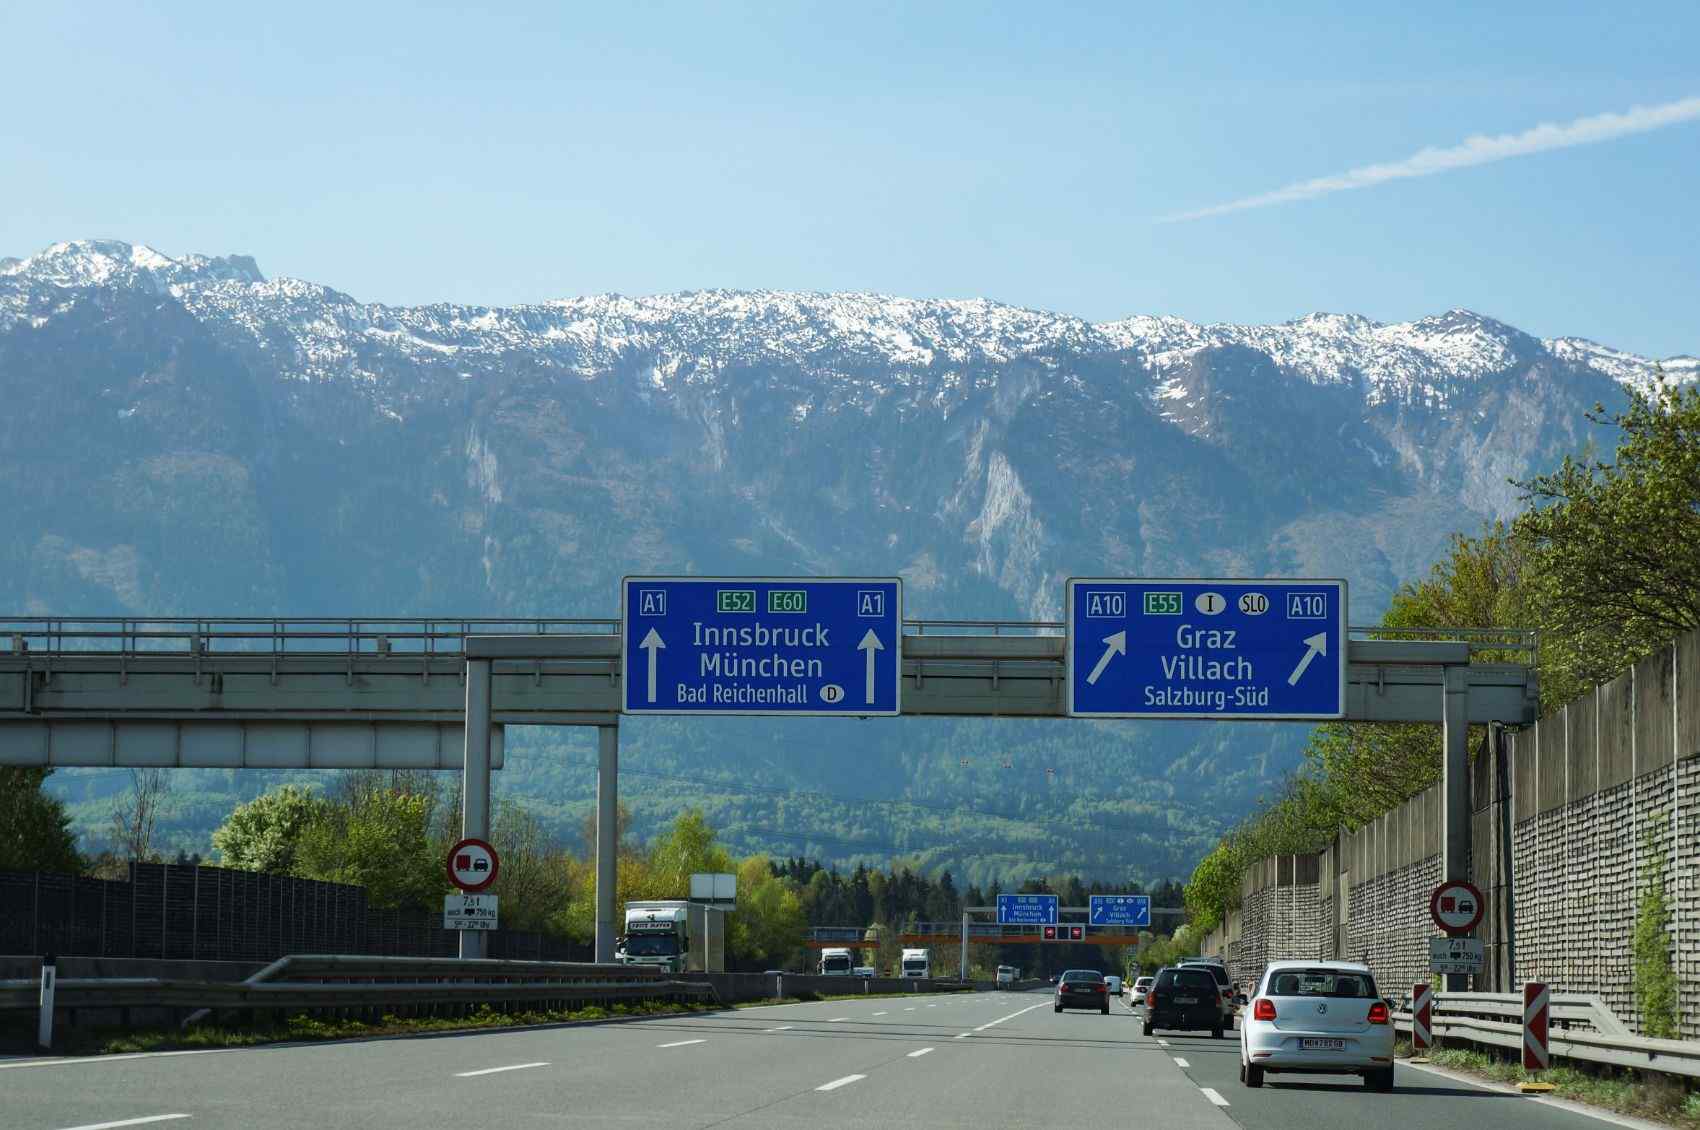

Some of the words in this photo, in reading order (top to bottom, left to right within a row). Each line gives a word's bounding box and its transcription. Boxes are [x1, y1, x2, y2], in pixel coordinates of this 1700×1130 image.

[643, 594, 664, 613] A1
[722, 593, 751, 610] E52
[773, 594, 803, 610] E60
[861, 595, 882, 613] A1
[1090, 595, 1122, 615] A10
[1148, 595, 1178, 612] E55
[1206, 595, 1213, 612] I
[1242, 595, 1265, 613] SLO
[1291, 596, 1323, 615] A10
[693, 622, 830, 647] Innsbruck
[1176, 625, 1236, 649] Graz
[700, 653, 823, 678] München
[1161, 655, 1252, 680] Villach
[677, 683, 706, 703] Bad
[713, 683, 807, 704] Reichenhall
[827, 686, 837, 701] D
[1144, 685, 1268, 711] Salzburg-Süd
